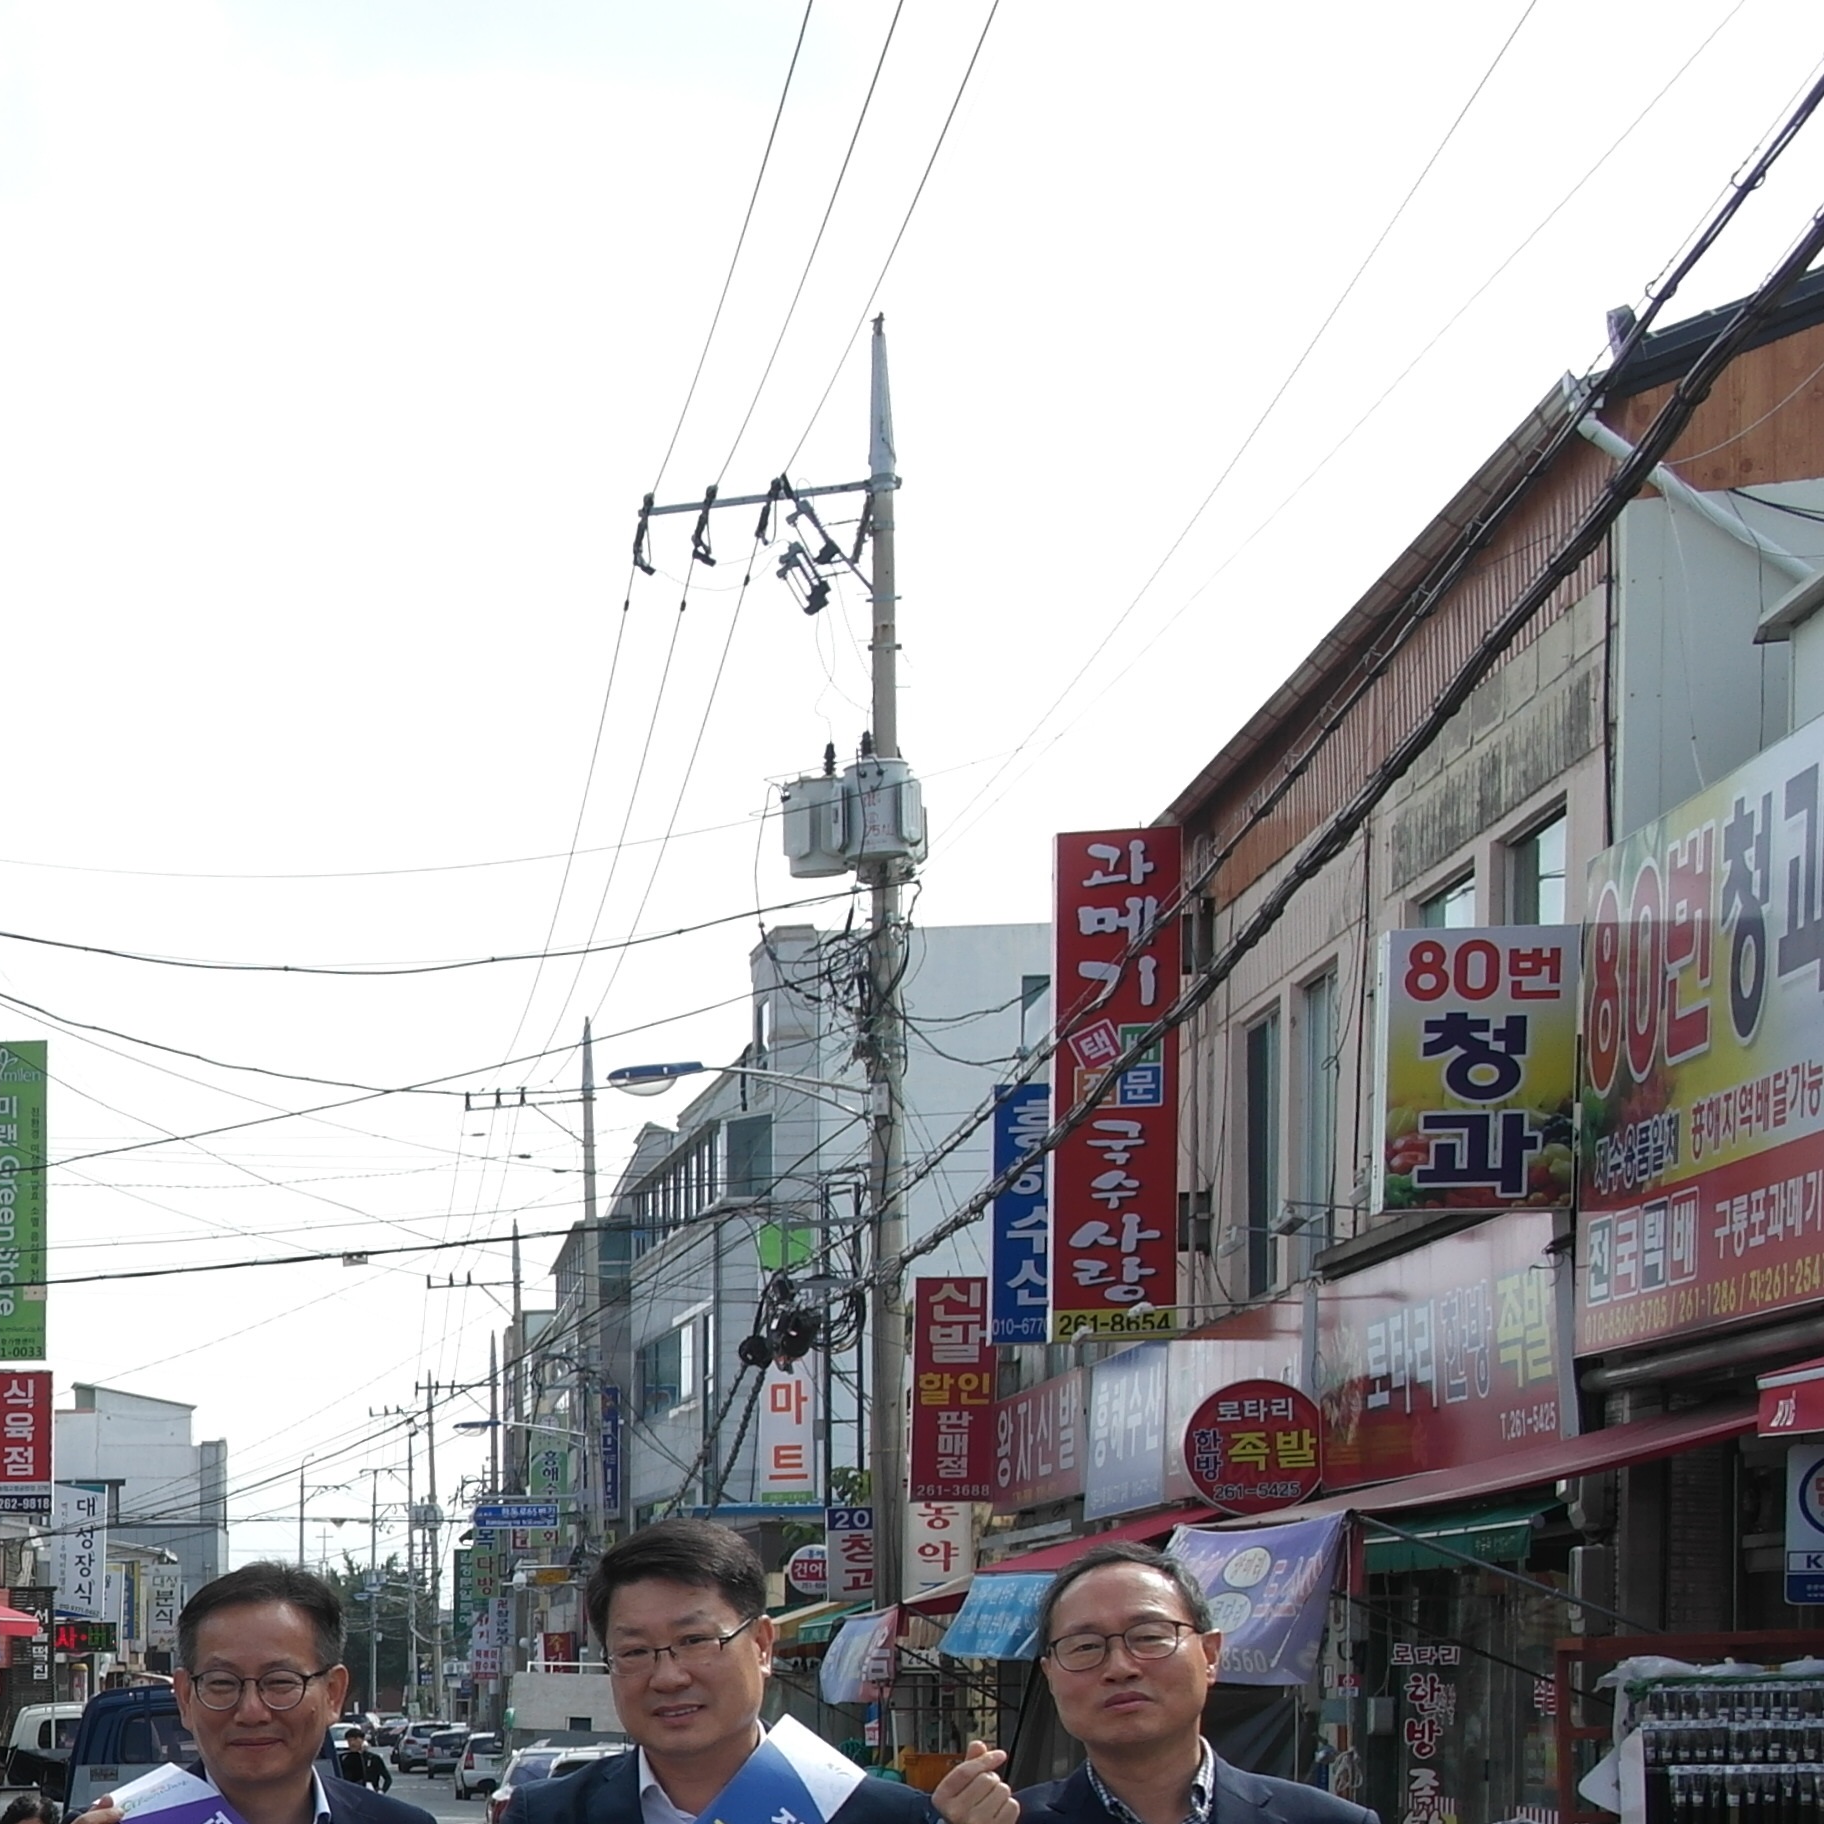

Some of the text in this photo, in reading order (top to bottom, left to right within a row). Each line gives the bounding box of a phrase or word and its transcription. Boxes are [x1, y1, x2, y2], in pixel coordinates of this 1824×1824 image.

[1078, 839, 1158, 1006] 과메기
[1404, 939, 1562, 1001] 80번
[1590, 822, 1714, 1099] 80번
[1417, 1010, 1544, 1196] 청과
[1589, 1196, 1696, 1299] 전국택배
[930, 1283, 987, 1364] 신발
[1059, 1313, 1172, 1336] 261-8654
[1367, 1299, 1439, 1414] 로타리
[1495, 1268, 1554, 1388] 족발
[918, 1372, 990, 1406] 할인
[1094, 1361, 1161, 1469] 흥해수산
[1217, 1398, 1294, 1422] 로타리
[3, 1379, 36, 1477] 식육점
[768, 1379, 809, 1481] 마트
[937, 1411, 974, 1479] 판매점
[997, 1381, 1077, 1489] 왕자신발
[1193, 1429, 1317, 1482] 한방 족발
[916, 1484, 990, 1498] 261-3688
[1213, 1482, 1301, 1500] 261-5425
[793, 1562, 827, 1579] 건어
[155, 1590, 174, 1626] 분식
[1391, 1644, 1460, 1666] 로타리
[1404, 1673, 1444, 1759] 한방
